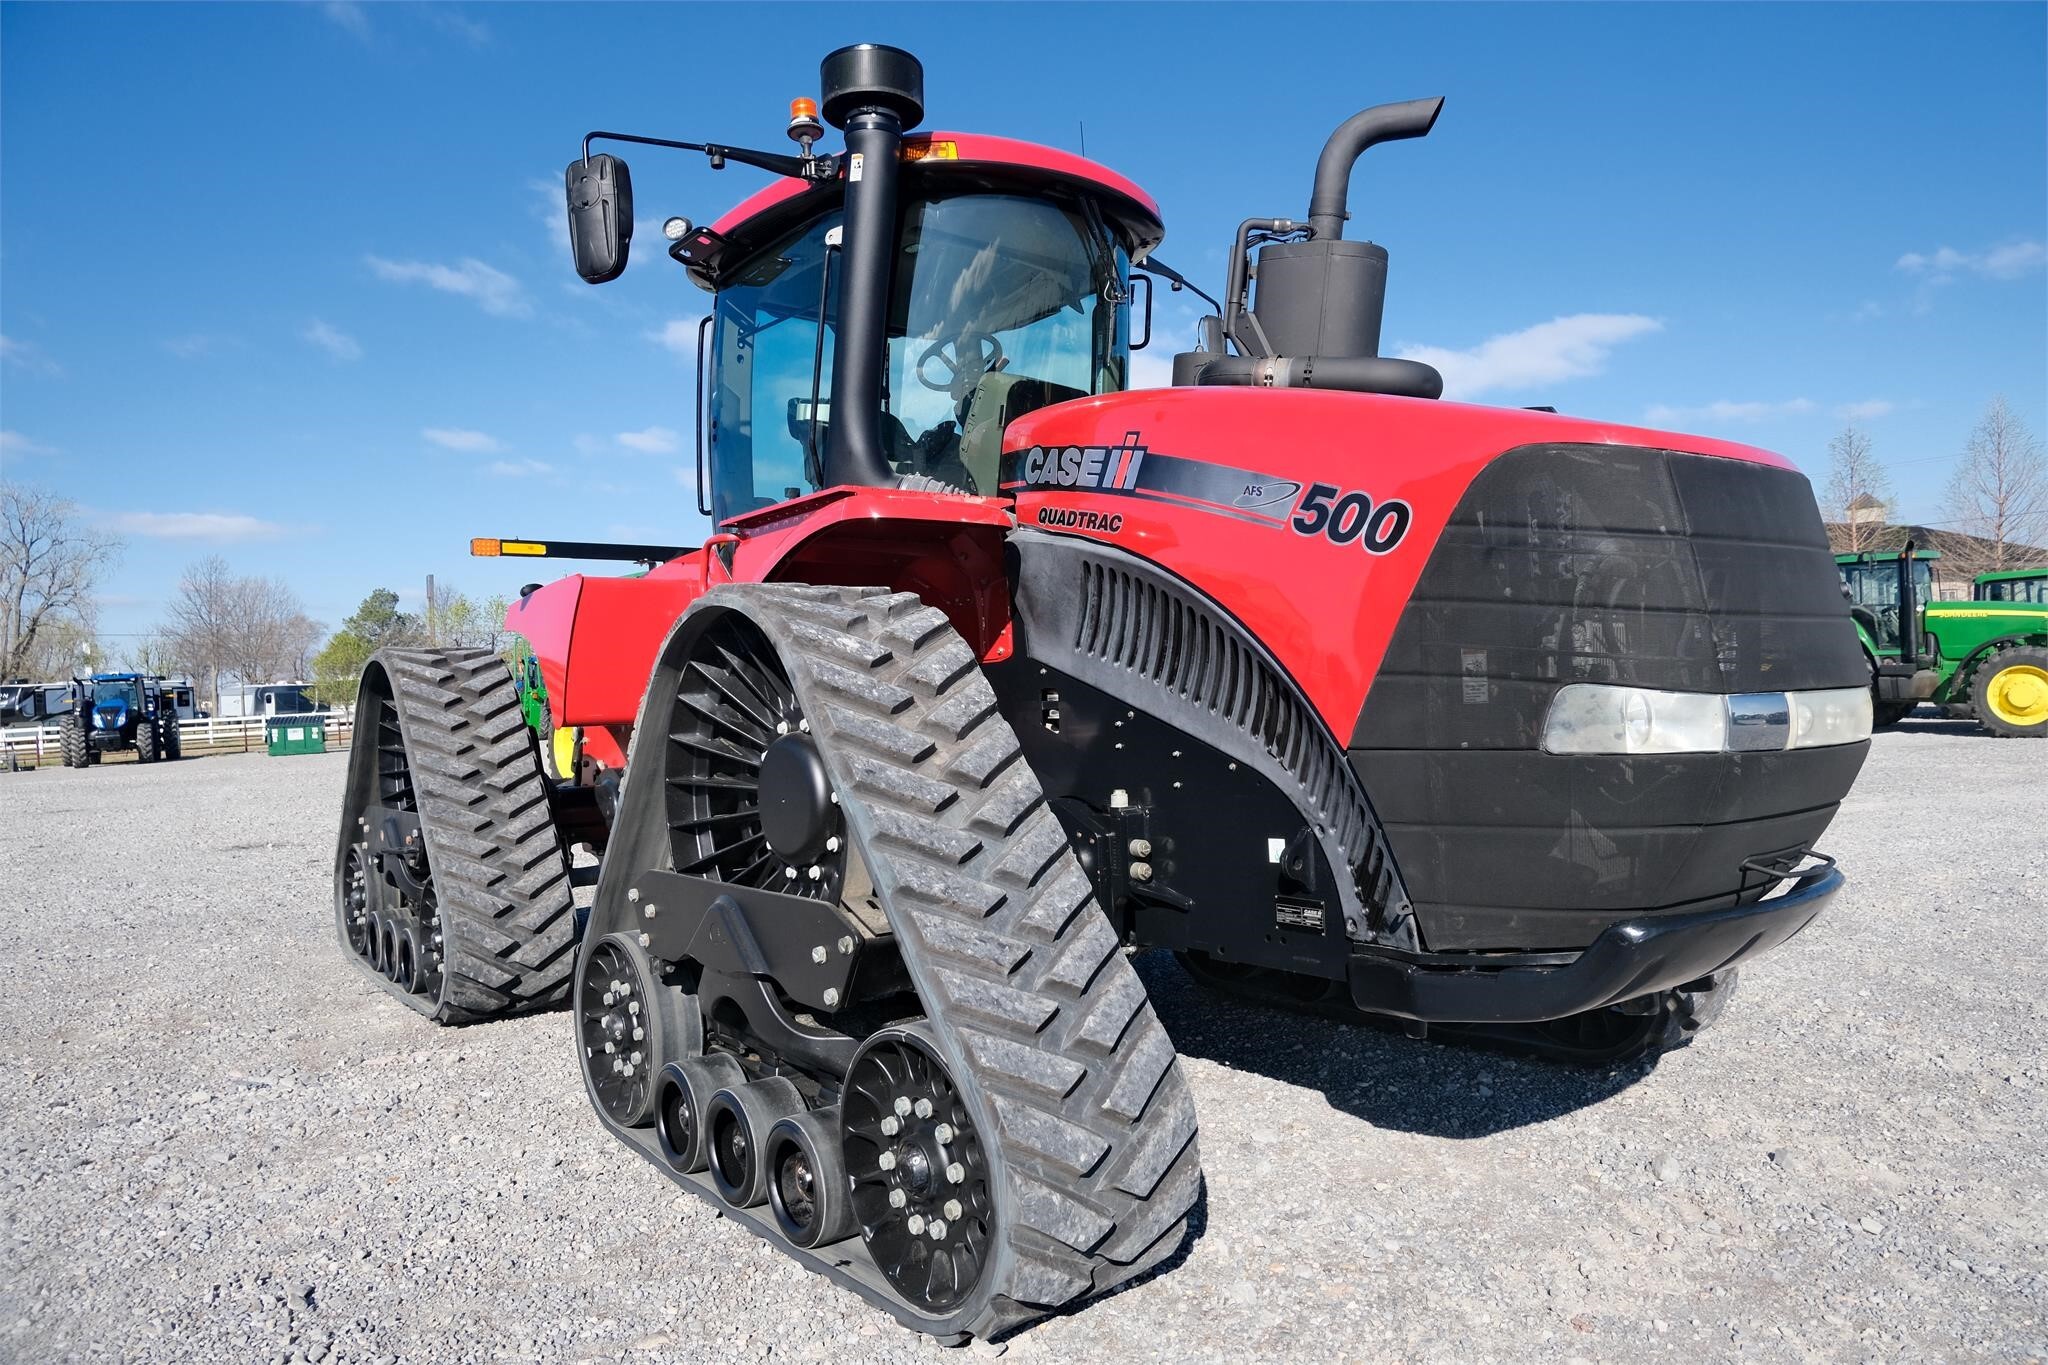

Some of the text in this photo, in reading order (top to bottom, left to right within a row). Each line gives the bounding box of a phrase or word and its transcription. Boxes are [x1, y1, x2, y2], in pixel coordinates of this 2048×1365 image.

[1024, 446, 1106, 487] CASE
[1243, 485, 1264, 497] AFS
[1038, 507, 1122, 532] QUADTRAC
[1292, 482, 1412, 555] 500
